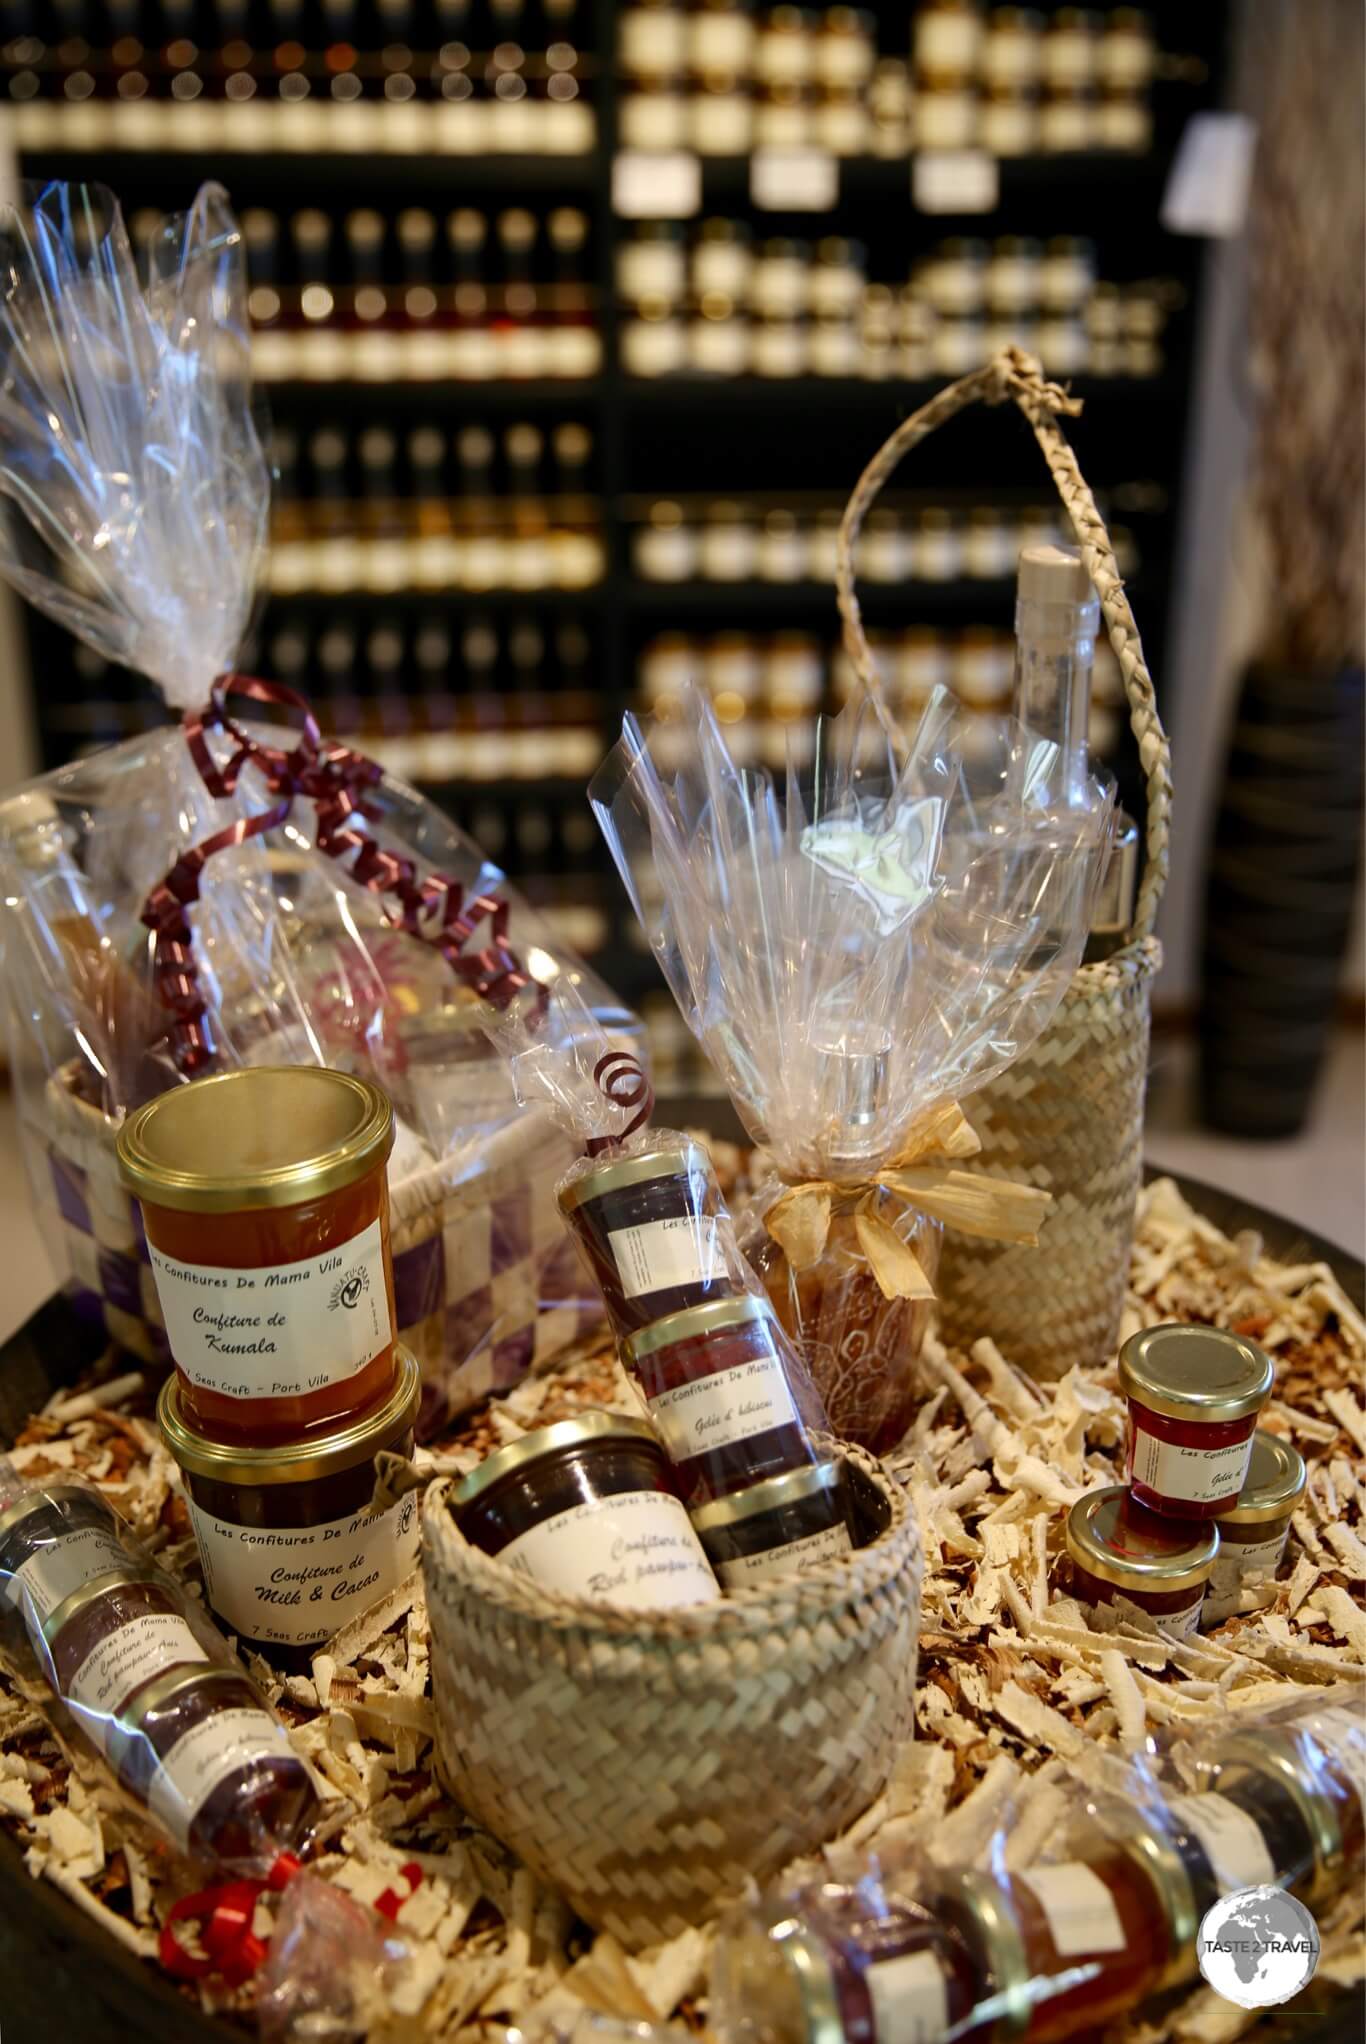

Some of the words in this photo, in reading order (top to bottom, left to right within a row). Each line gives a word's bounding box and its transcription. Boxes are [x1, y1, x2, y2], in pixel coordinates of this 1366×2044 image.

[165, 1263, 228, 1288] Confitures
[237, 1277, 255, 1289] De
[264, 1270, 311, 1287] Mama
[319, 1256, 343, 1275] Vila
[193, 1307, 261, 1329] Confiture
[267, 1312, 286, 1327] de
[205, 1334, 278, 1355] Kumala
[195, 1372, 216, 1387] Seas
[221, 1382, 250, 1395] Craft
[272, 1382, 301, 1394] Port
[308, 1374, 329, 1388] Vila
[672, 1377, 724, 1402] Confitures
[729, 1370, 742, 1382] De
[1181, 1448, 1198, 1457] Les
[214, 1523, 233, 1538] Les
[240, 1532, 316, 1546] Confitures
[323, 1528, 341, 1541] De
[270, 1565, 343, 1585] Confiture
[349, 1553, 365, 1570] de
[745, 1558, 763, 1568] Les
[255, 1585, 302, 1606] Milk
[309, 1585, 324, 1601] &
[331, 1570, 380, 1601] Cacao
[121, 1627, 136, 1639] De
[252, 1625, 260, 1636] 7
[266, 1628, 291, 1641] Seas
[296, 1628, 329, 1641] Craft
